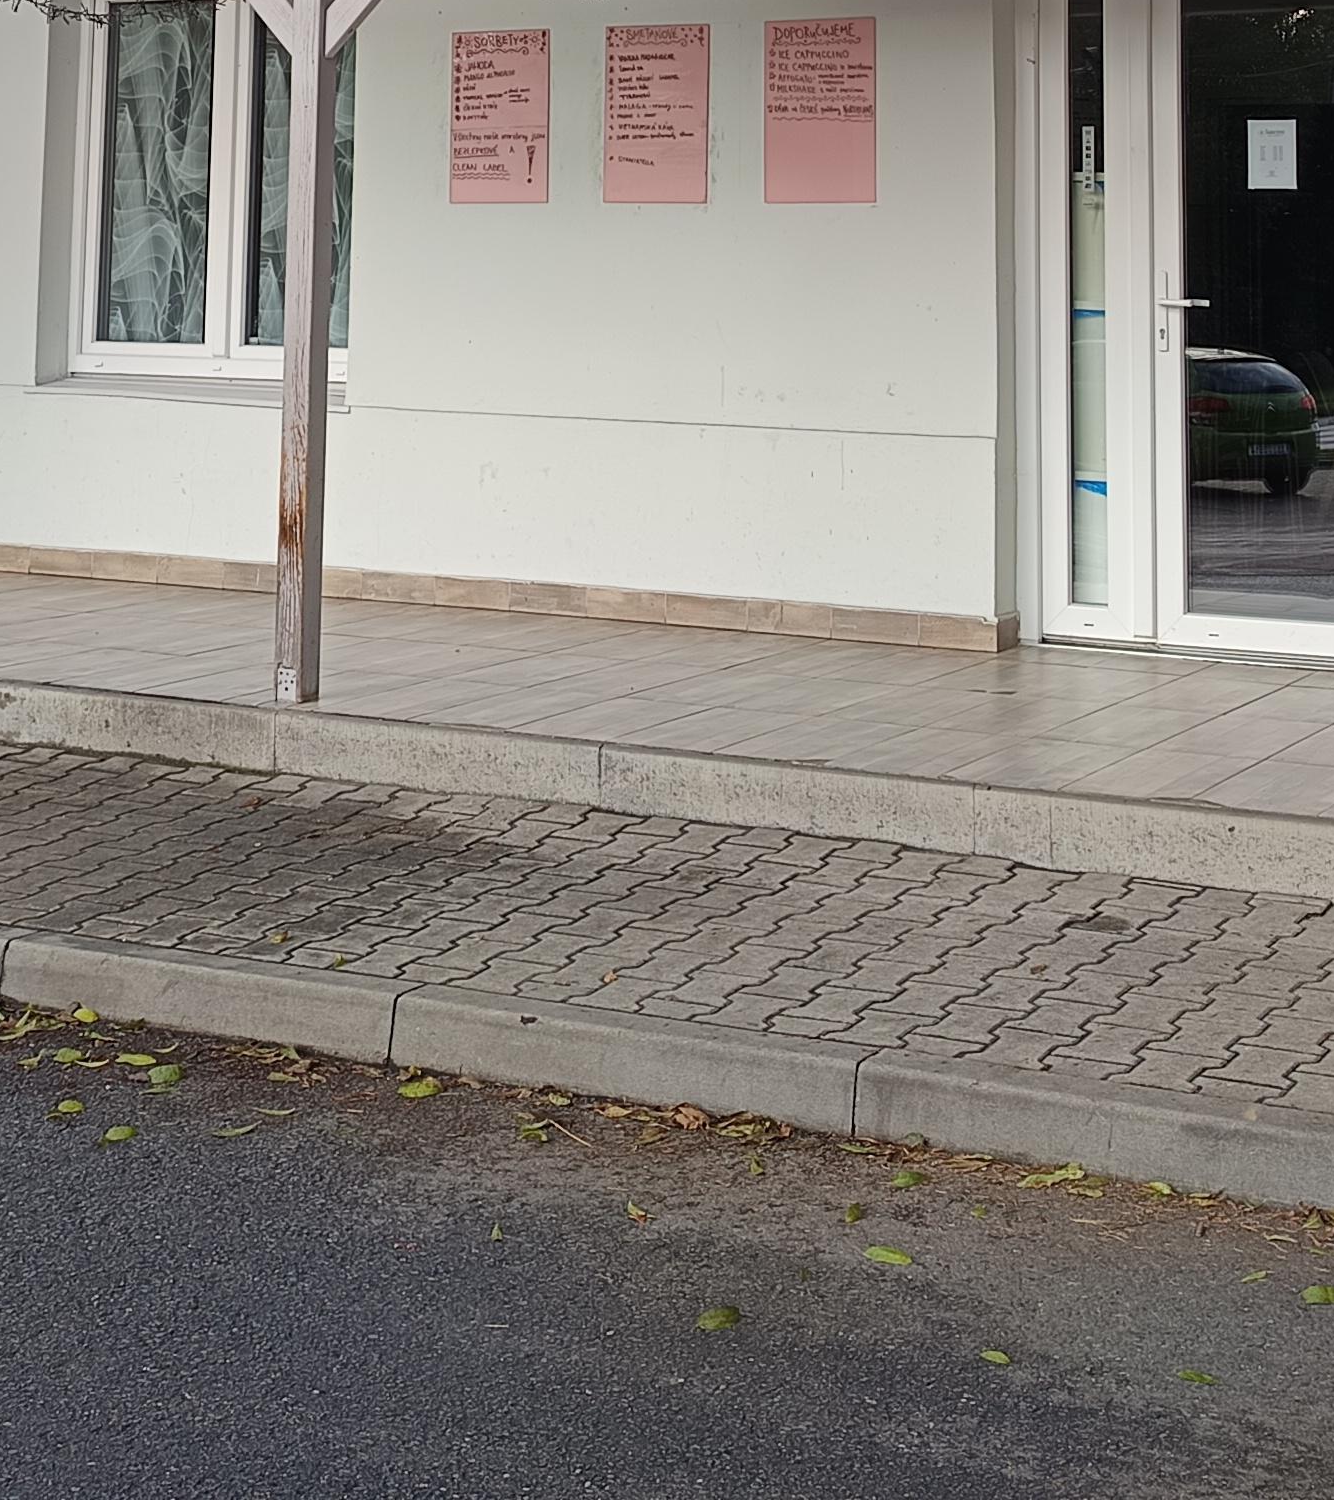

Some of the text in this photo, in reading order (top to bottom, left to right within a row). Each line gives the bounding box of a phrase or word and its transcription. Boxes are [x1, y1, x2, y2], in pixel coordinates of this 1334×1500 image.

[474, 33, 519, 48] SORBETY
[778, 49, 850, 60] ICE CAPPUCCINO
